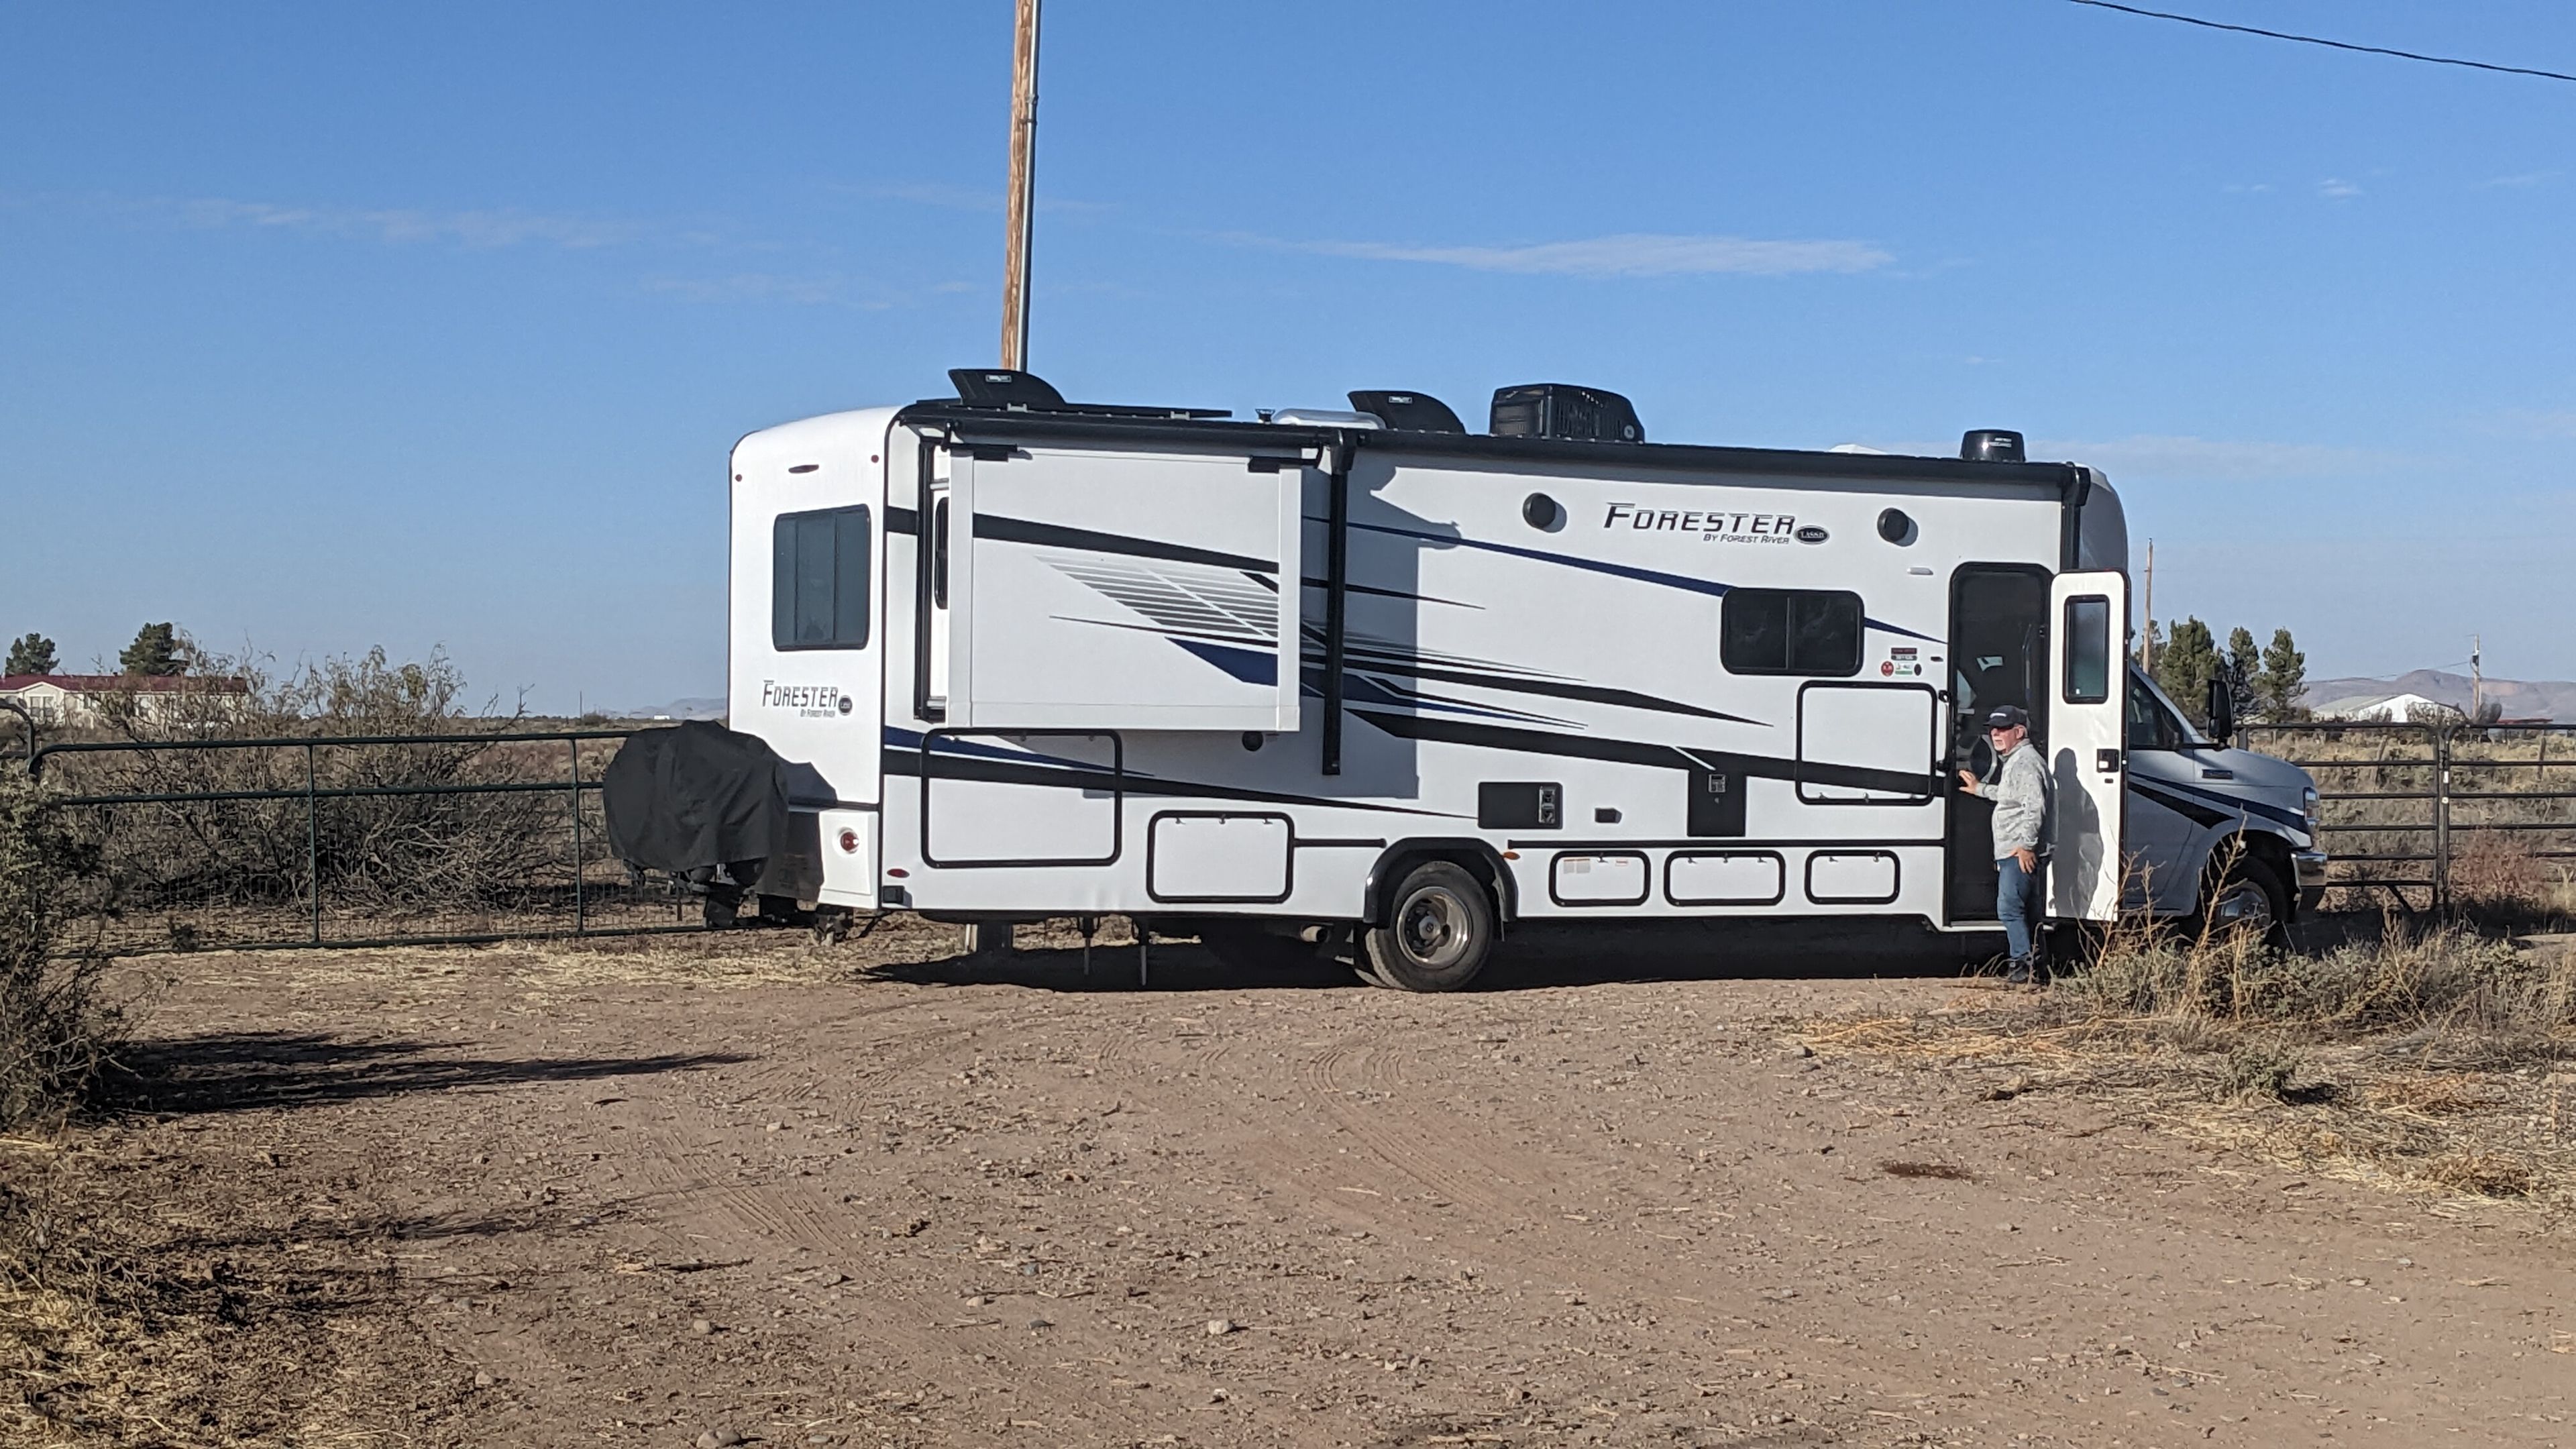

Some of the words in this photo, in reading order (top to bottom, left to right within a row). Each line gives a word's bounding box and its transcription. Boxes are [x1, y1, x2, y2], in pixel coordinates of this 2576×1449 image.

[1603, 502, 1796, 535] FORESTER
[1703, 533, 1717, 541] BY
[1720, 534, 1758, 543] FOREST
[1761, 535, 1790, 544] RIVER
[762, 680, 839, 707] FORESTER
